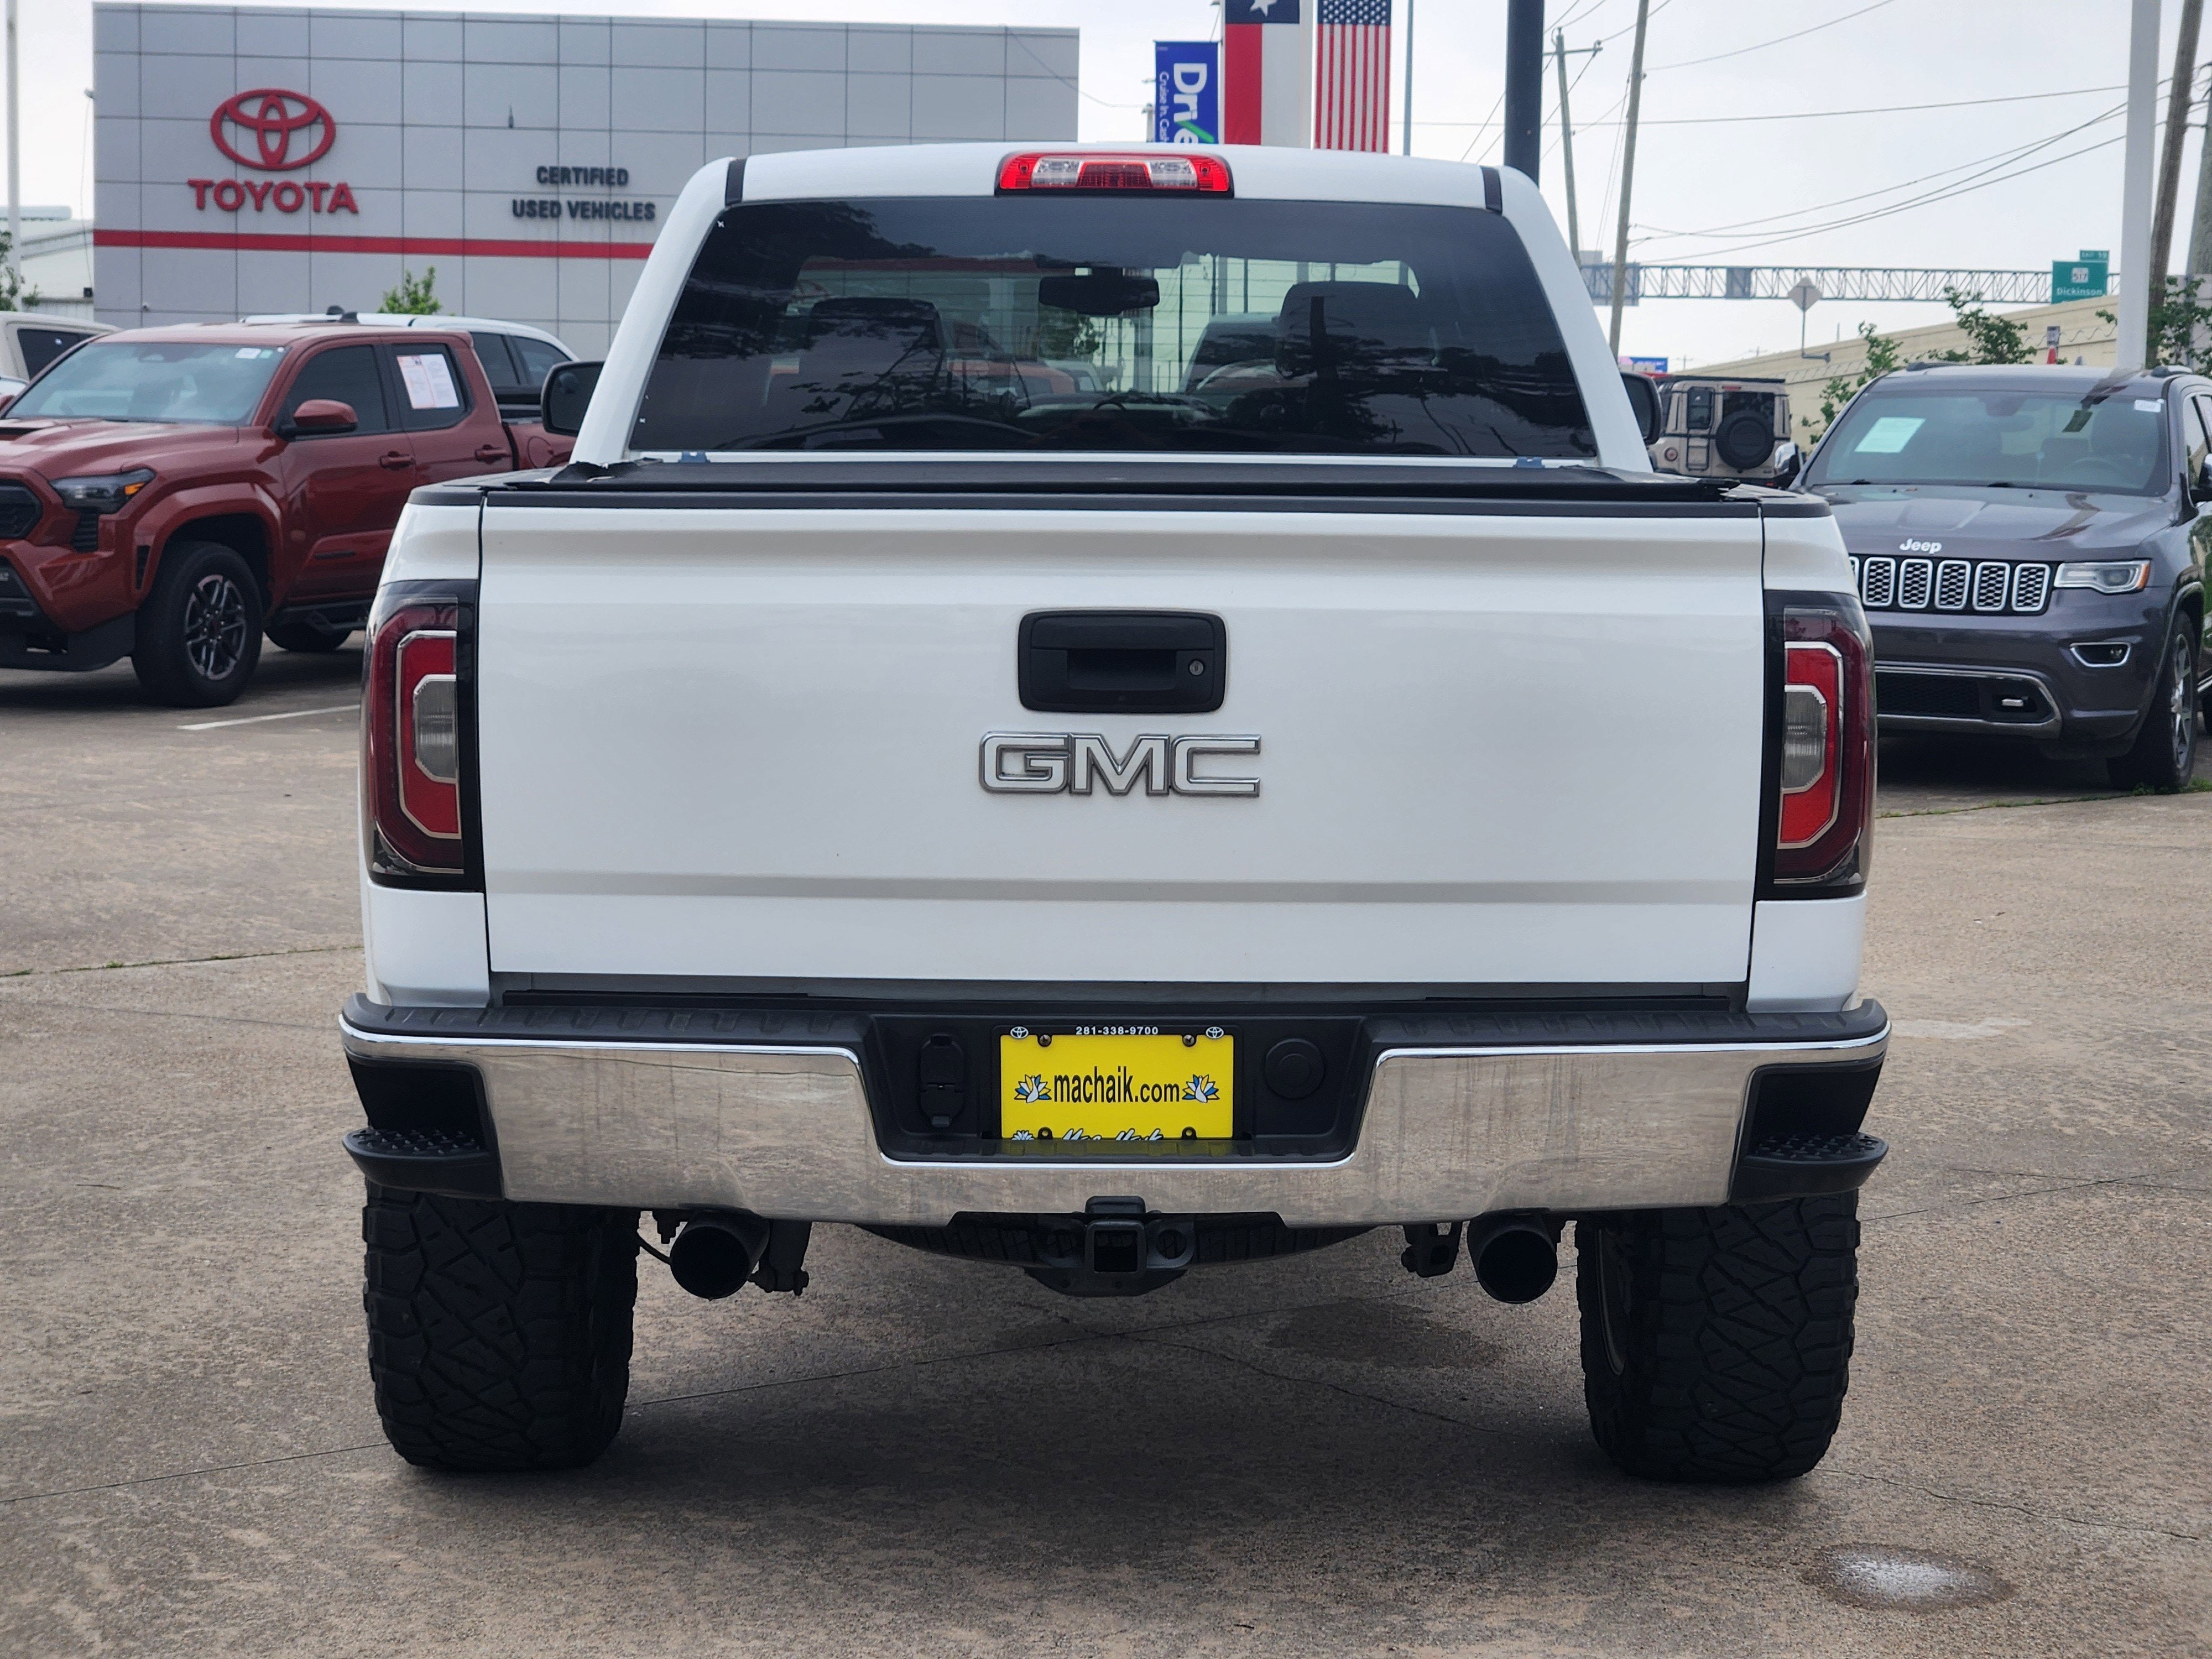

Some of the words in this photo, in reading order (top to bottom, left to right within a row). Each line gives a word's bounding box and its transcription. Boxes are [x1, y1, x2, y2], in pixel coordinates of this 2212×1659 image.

[536, 165, 629, 187] CERTIFIED
[187, 178, 358, 214] TOYOTA
[512, 199, 561, 220] USED
[566, 200, 656, 221] VEHICLES
[2057, 287, 2103, 295] Dickinson
[1900, 538, 1942, 554] Jeep
[979, 731, 1261, 797] GMC
[1076, 1026, 1159, 1035] 281-338-9700
[1053, 1066, 1180, 1103] machaik.com
